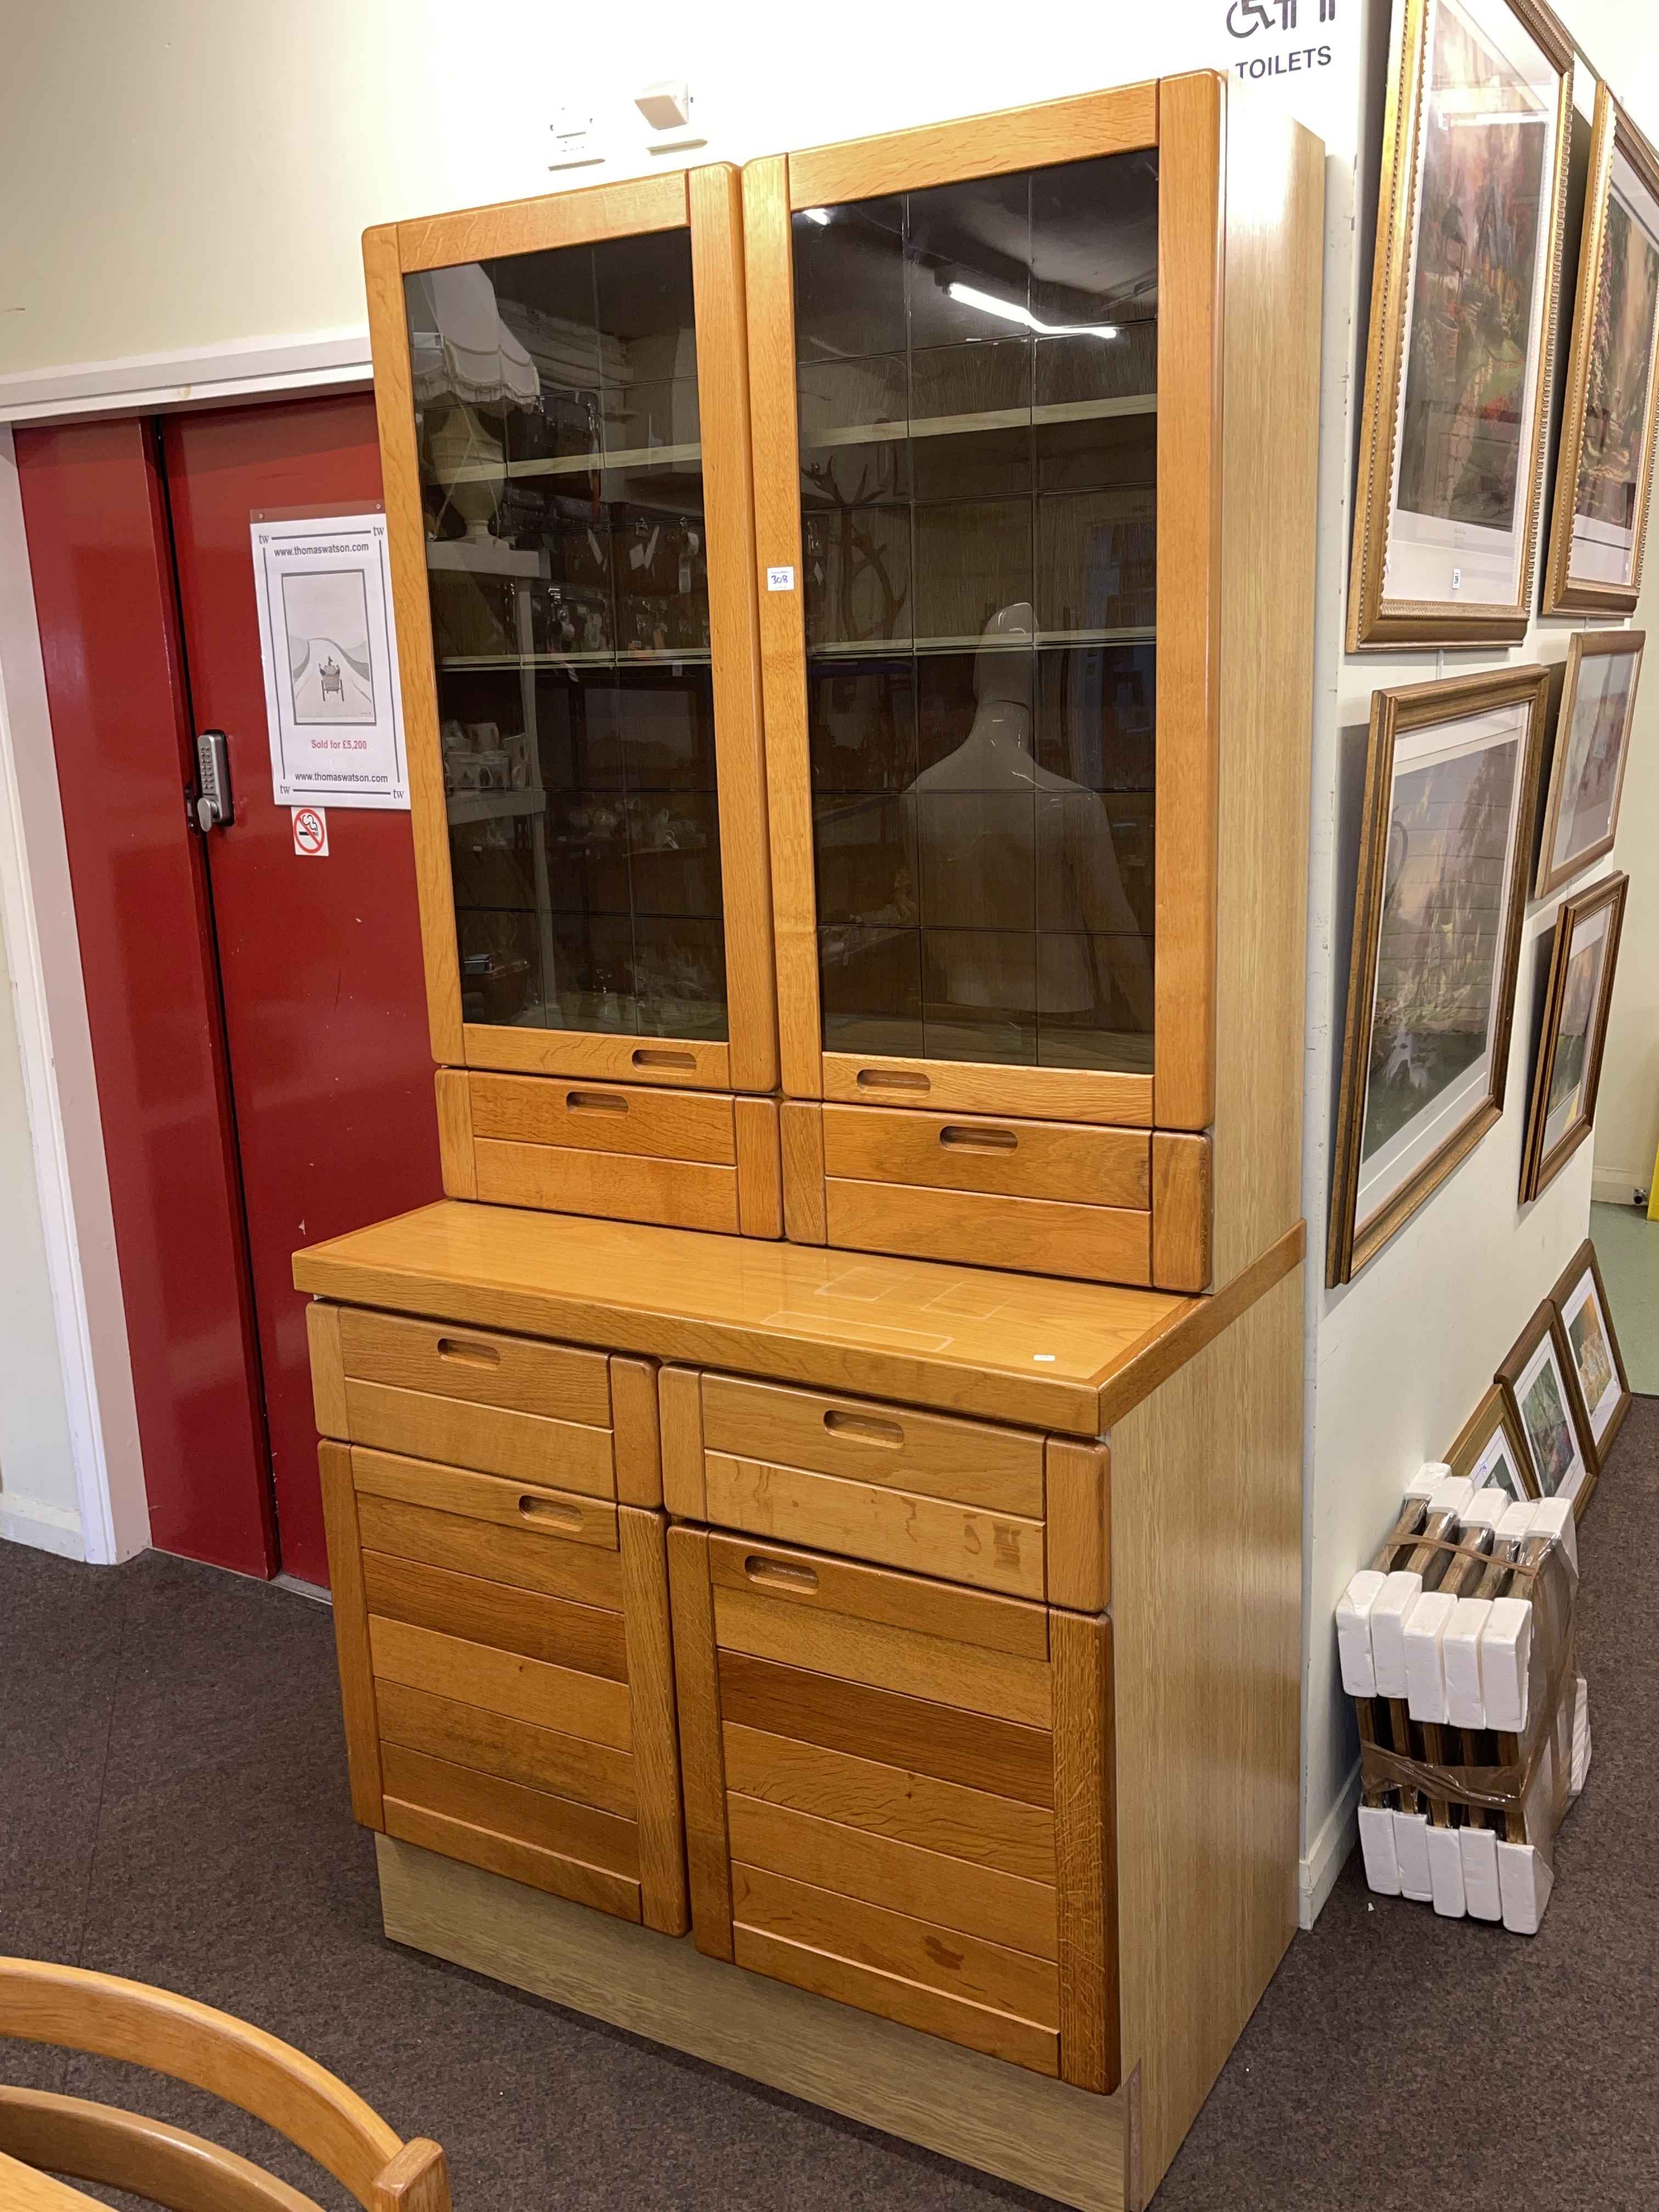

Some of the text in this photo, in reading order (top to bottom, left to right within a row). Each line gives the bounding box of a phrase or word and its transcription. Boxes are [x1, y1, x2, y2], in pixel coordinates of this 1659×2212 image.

[1235, 46, 1331, 79] TOILETS
[373, 526, 384, 537] tw
[258, 533, 270, 544] tw
[274, 543, 369, 557] www.thomaswatson.com
[771, 574, 788, 584] 308
[311, 740, 367, 750] Sold for £5,200
[295, 772, 388, 783] www.thomaswatson.com
[280, 784, 290, 794] tw
[393, 789, 404, 799] tw
